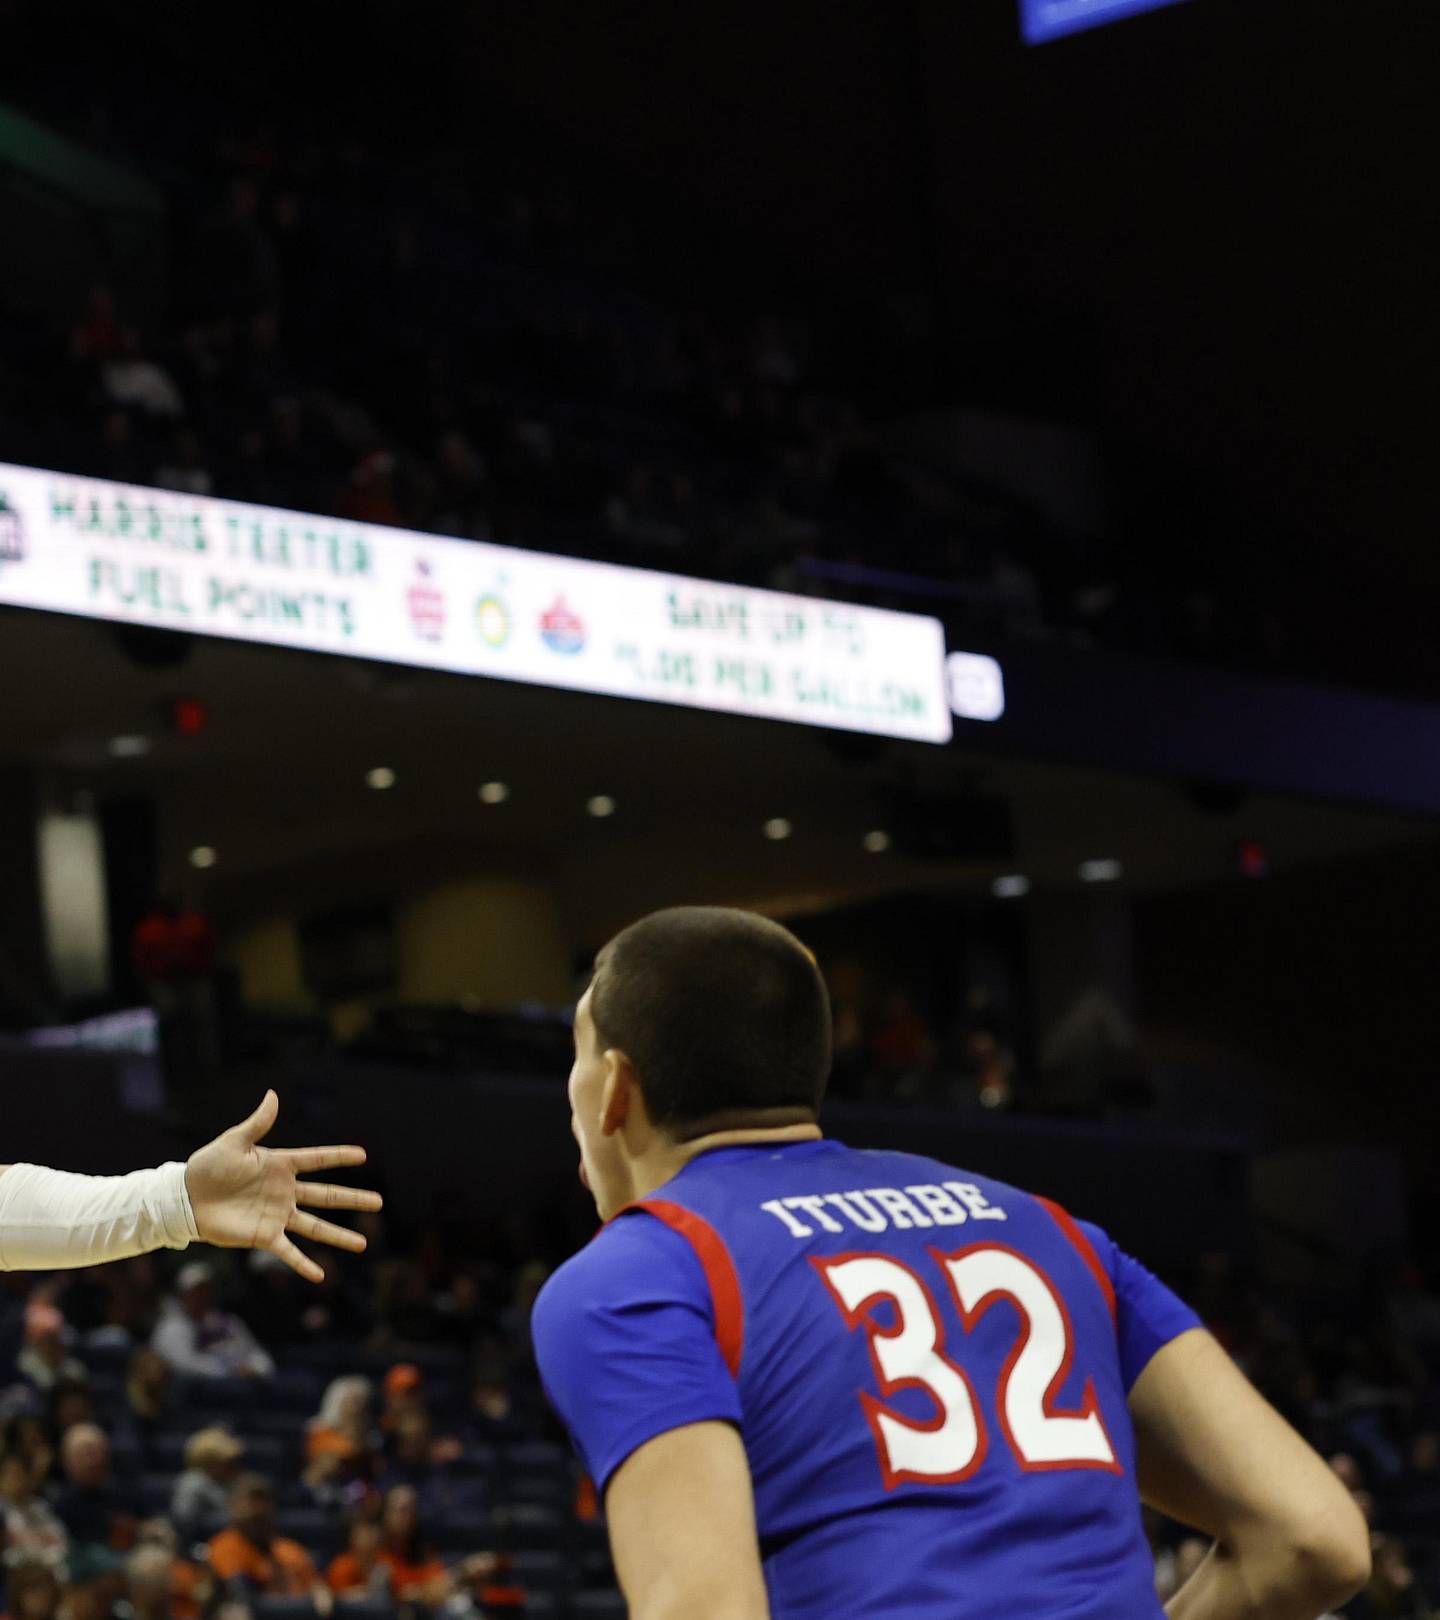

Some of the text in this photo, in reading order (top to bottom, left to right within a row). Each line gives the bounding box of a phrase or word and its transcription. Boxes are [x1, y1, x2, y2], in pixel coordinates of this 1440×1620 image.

[50, 490, 208, 555] HARRIS
[226, 515, 374, 576] TEETER
[88, 556, 192, 615] FUEL
[208, 576, 357, 638] POINTS
[761, 1181, 1008, 1238] ITURBE
[808, 1241, 1123, 1492] 32
